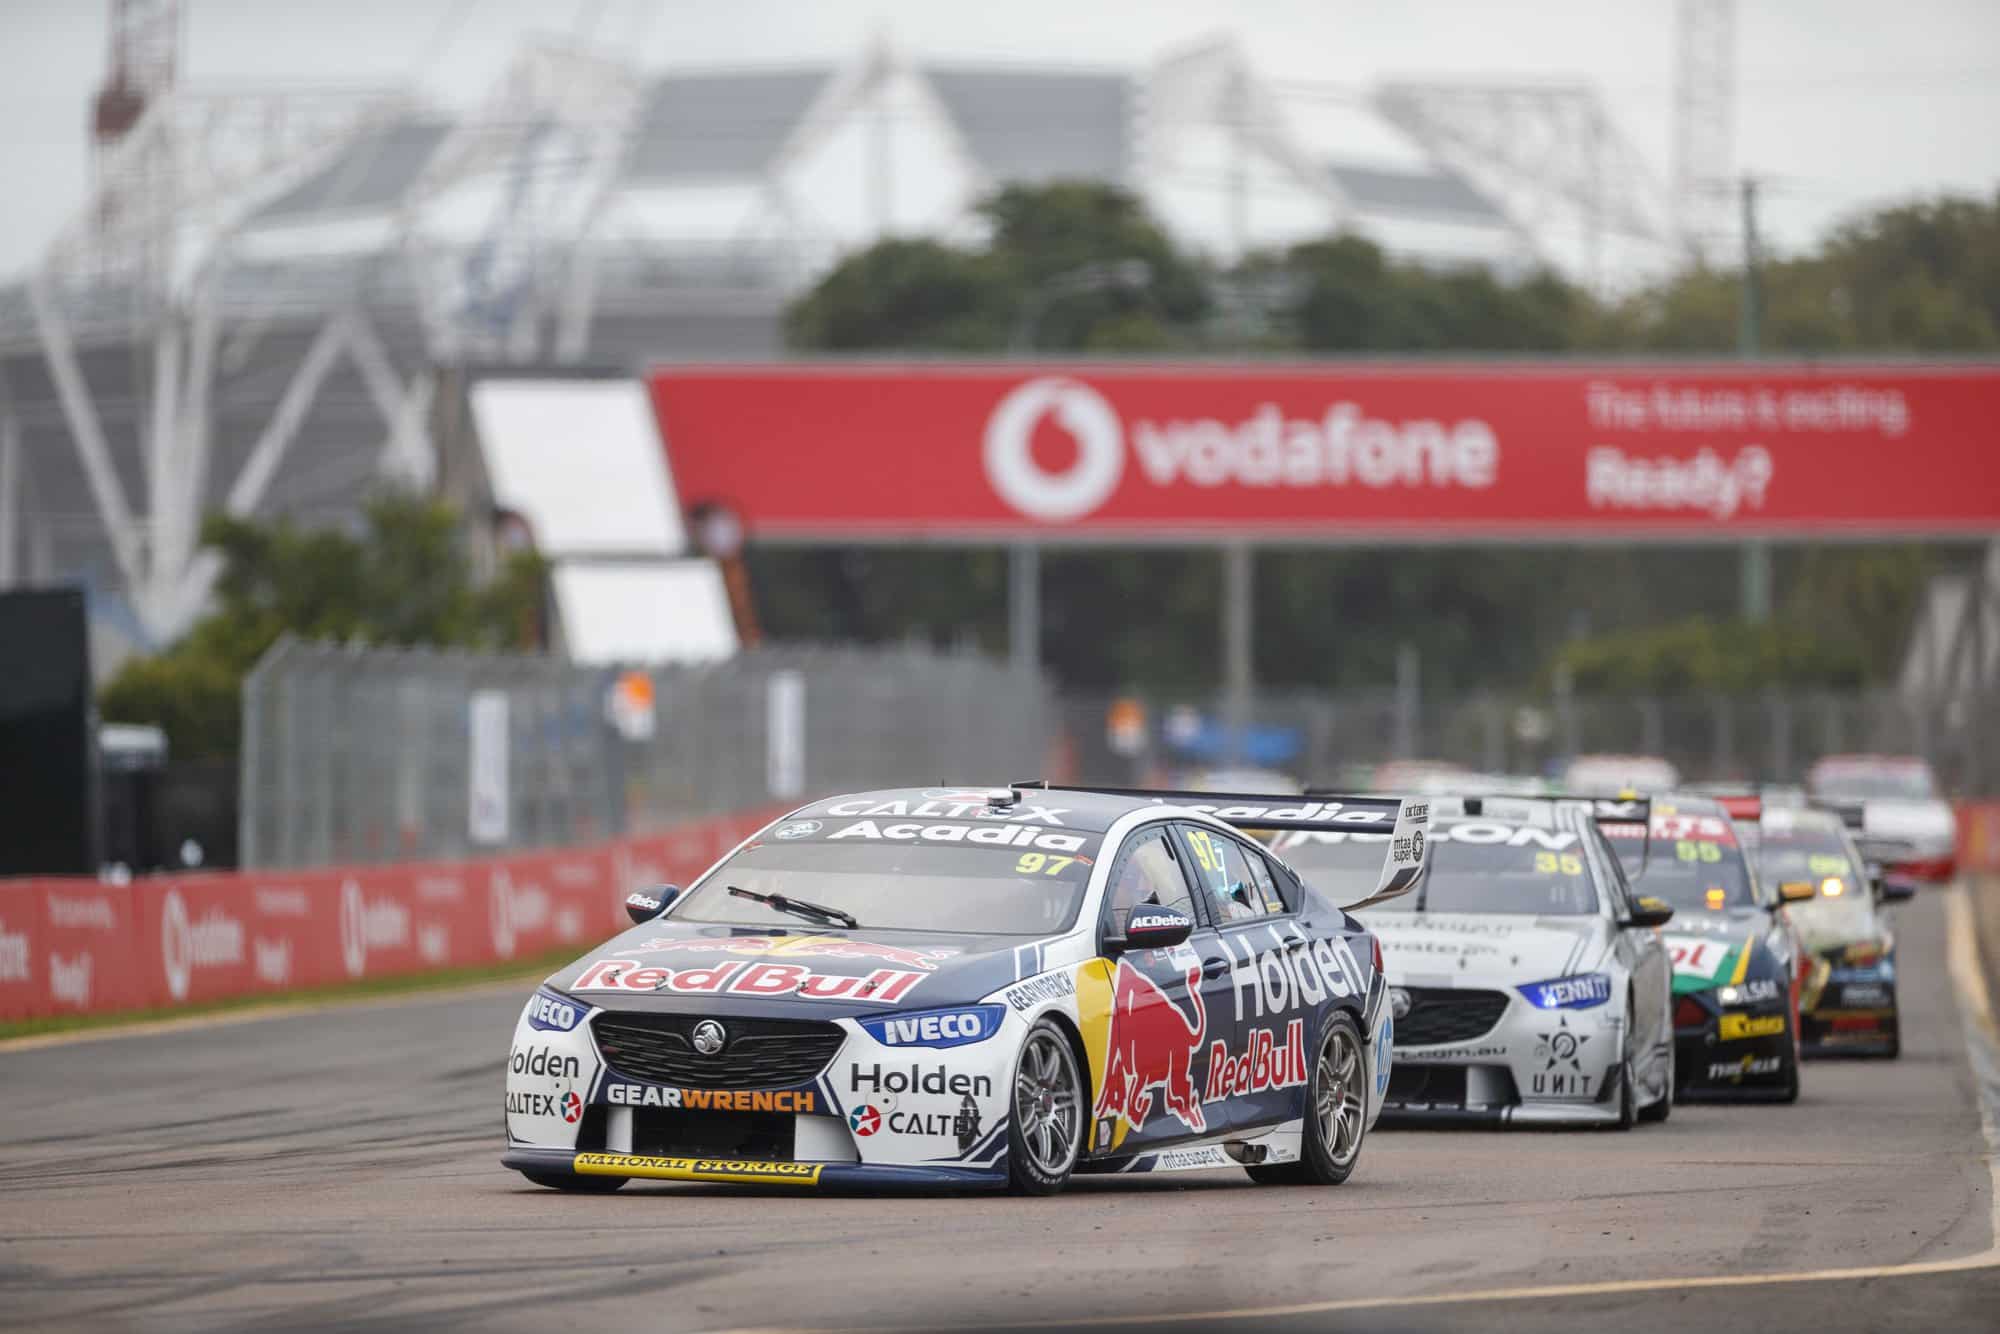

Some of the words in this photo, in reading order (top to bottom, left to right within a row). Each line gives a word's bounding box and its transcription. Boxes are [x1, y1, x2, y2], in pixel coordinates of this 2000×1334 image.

[1132, 402, 1496, 487] vodafone
[1587, 445, 1772, 518] Ready?
[1190, 803, 1387, 823] cadia
[826, 820, 1087, 852] Acadia
[1186, 831, 1218, 871] 97
[1394, 837, 1411, 850] mtaa
[1015, 853, 1074, 875] 97
[1393, 849, 1411, 863] super
[1536, 852, 1582, 876] 35
[1131, 915, 1189, 928] ACDelco
[570, 961, 739, 991] Red
[728, 963, 929, 1003] Bull
[1218, 920, 1366, 1021] Holden
[1006, 971, 1075, 1011] GEARWRENCH
[532, 994, 575, 1029] VECO
[884, 1014, 981, 1044] IVECO
[1203, 1028, 1257, 1104] Red
[1251, 1018, 1308, 1093] Bull
[851, 1063, 991, 1097] Holden
[607, 1084, 815, 1112] GEARWRENCH
[888, 1112, 983, 1137] CALTEX
[579, 1154, 688, 1169] NATIONAL
[698, 1159, 811, 1175] STORAGE
